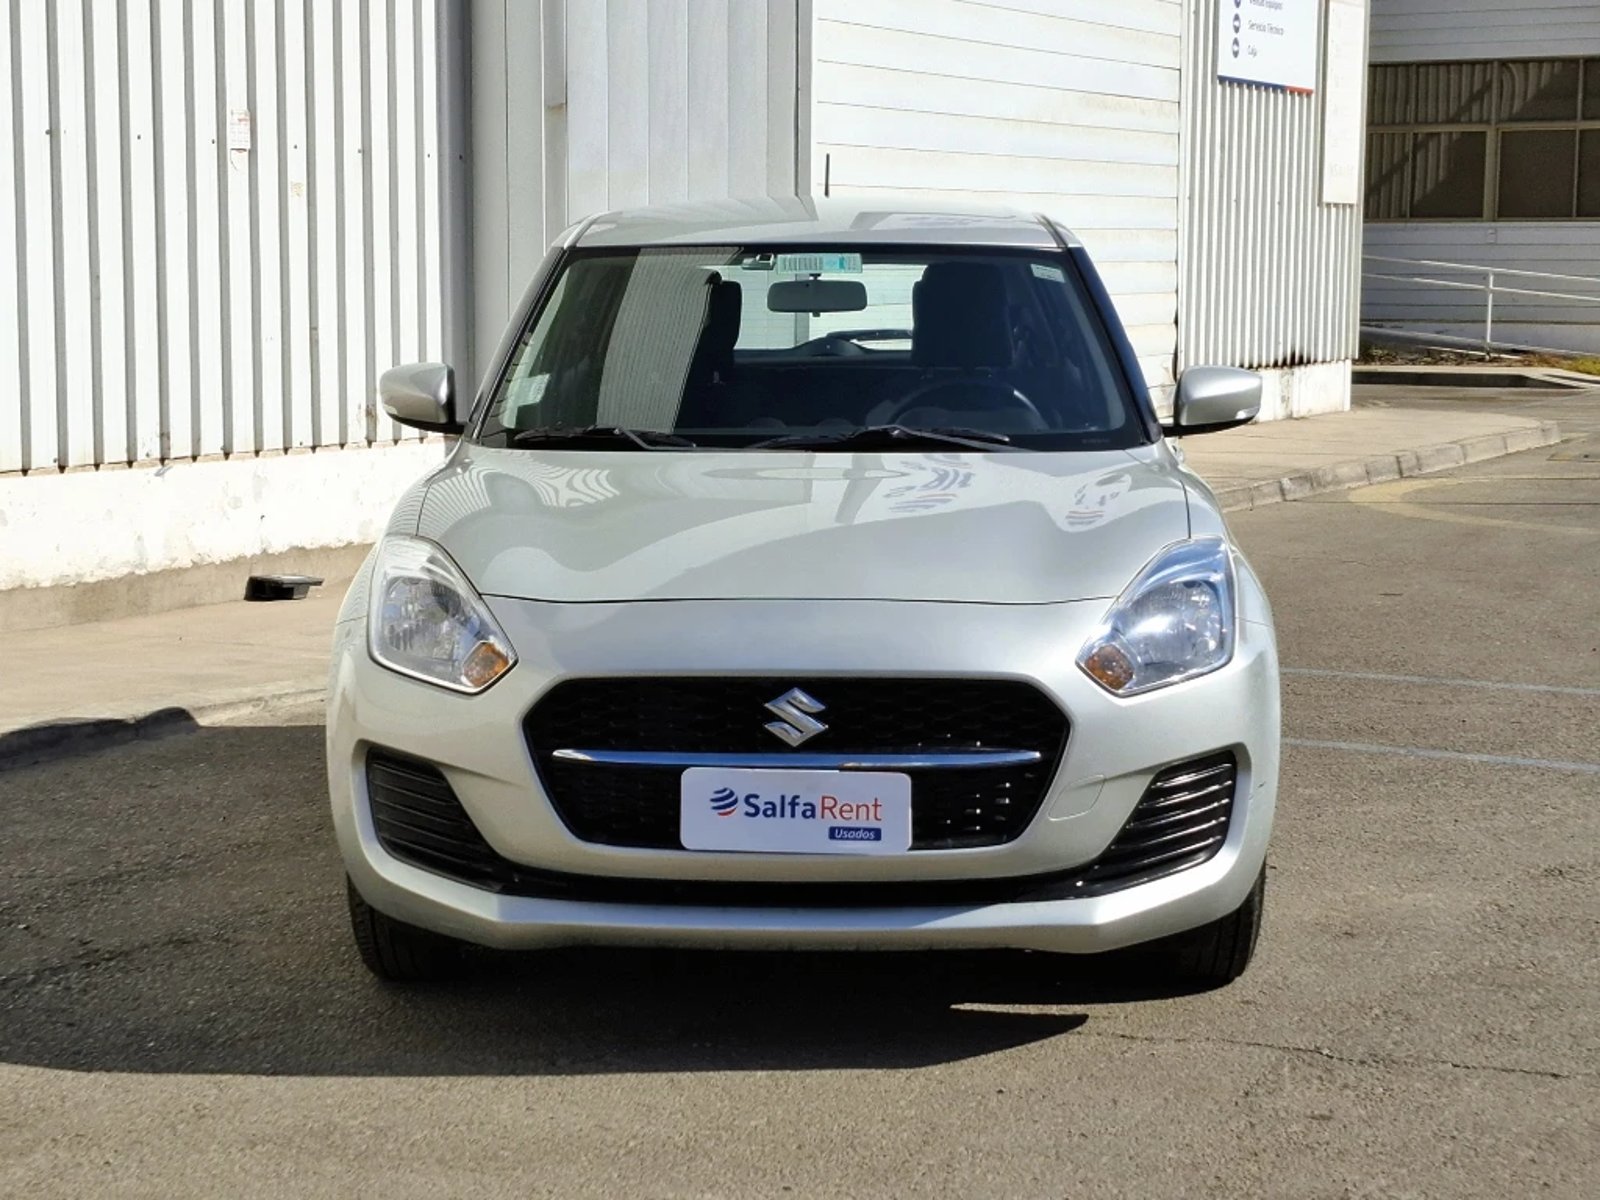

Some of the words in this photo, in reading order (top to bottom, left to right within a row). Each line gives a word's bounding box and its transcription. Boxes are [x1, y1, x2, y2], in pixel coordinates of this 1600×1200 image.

[1248, 20, 1266, 32] Servicio
[743, 793, 882, 821] SalfaRent
[835, 828, 875, 840] Usados
